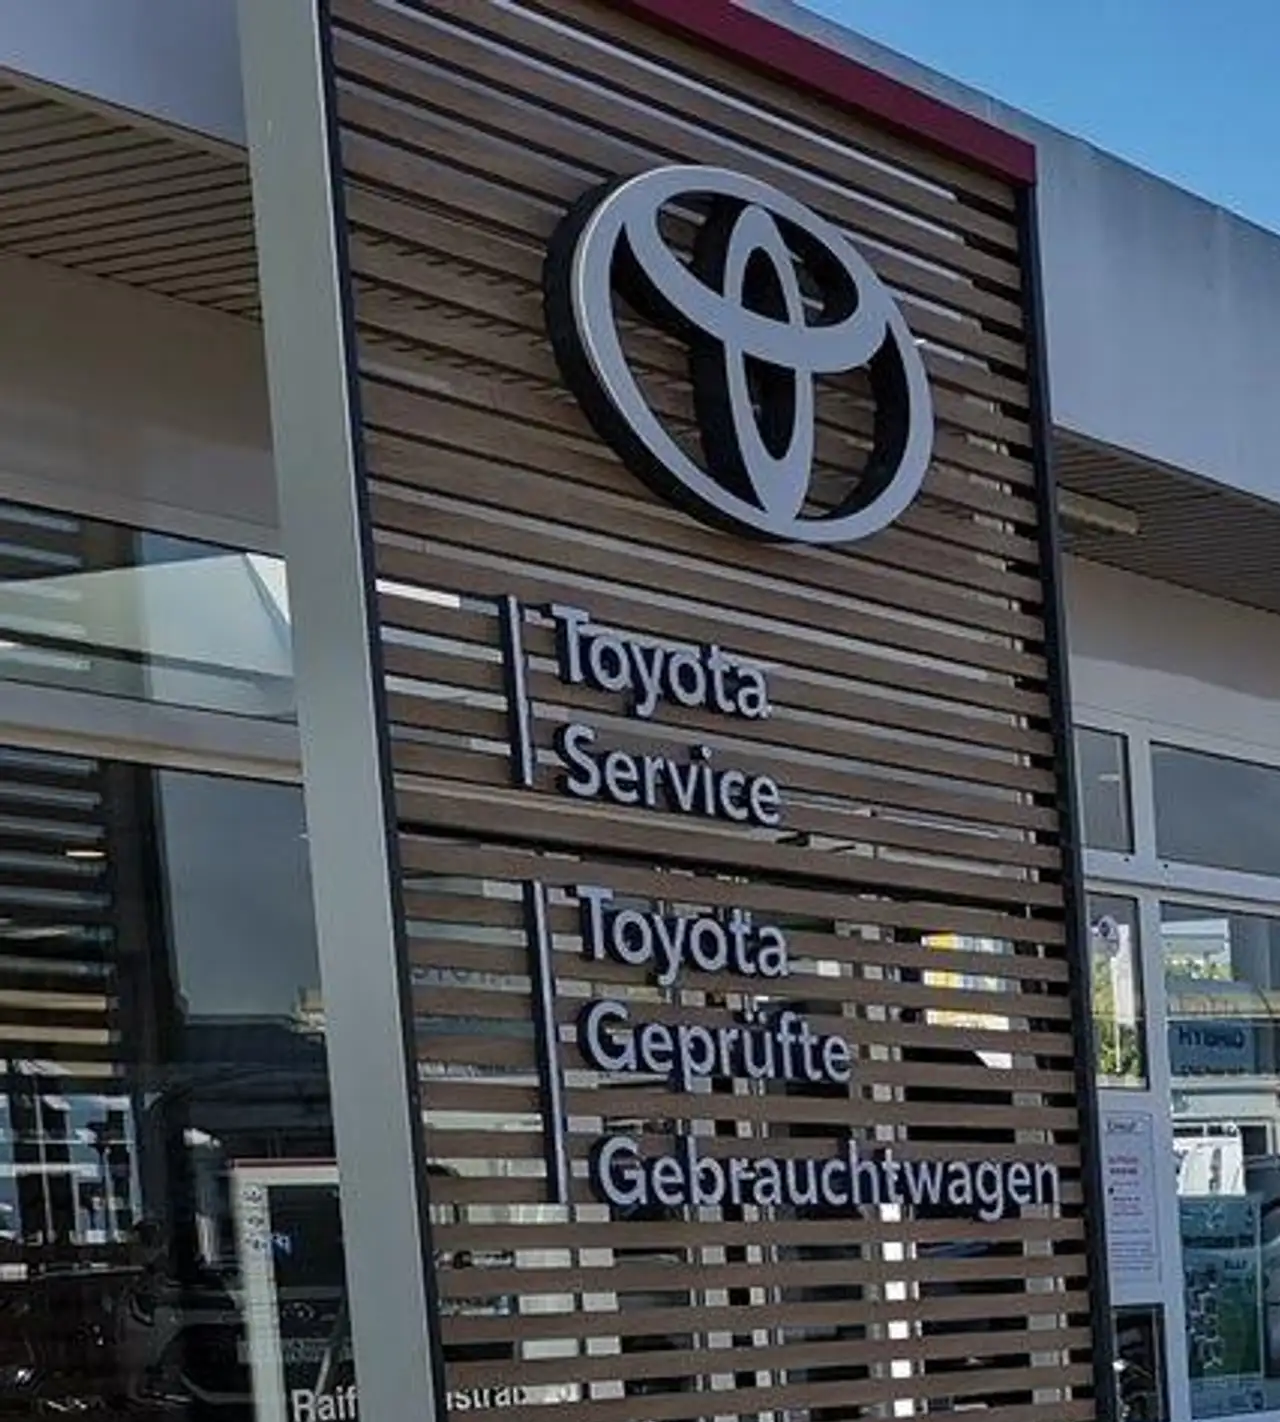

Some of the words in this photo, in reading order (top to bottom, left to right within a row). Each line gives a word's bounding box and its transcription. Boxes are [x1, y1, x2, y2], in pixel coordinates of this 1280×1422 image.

[552, 603, 773, 719] Toyota
[562, 724, 782, 825] Service
[576, 884, 790, 986] Toyota
[586, 1000, 853, 1093] Geprüfte
[598, 1135, 1061, 1222] Gebrauchtwagen
